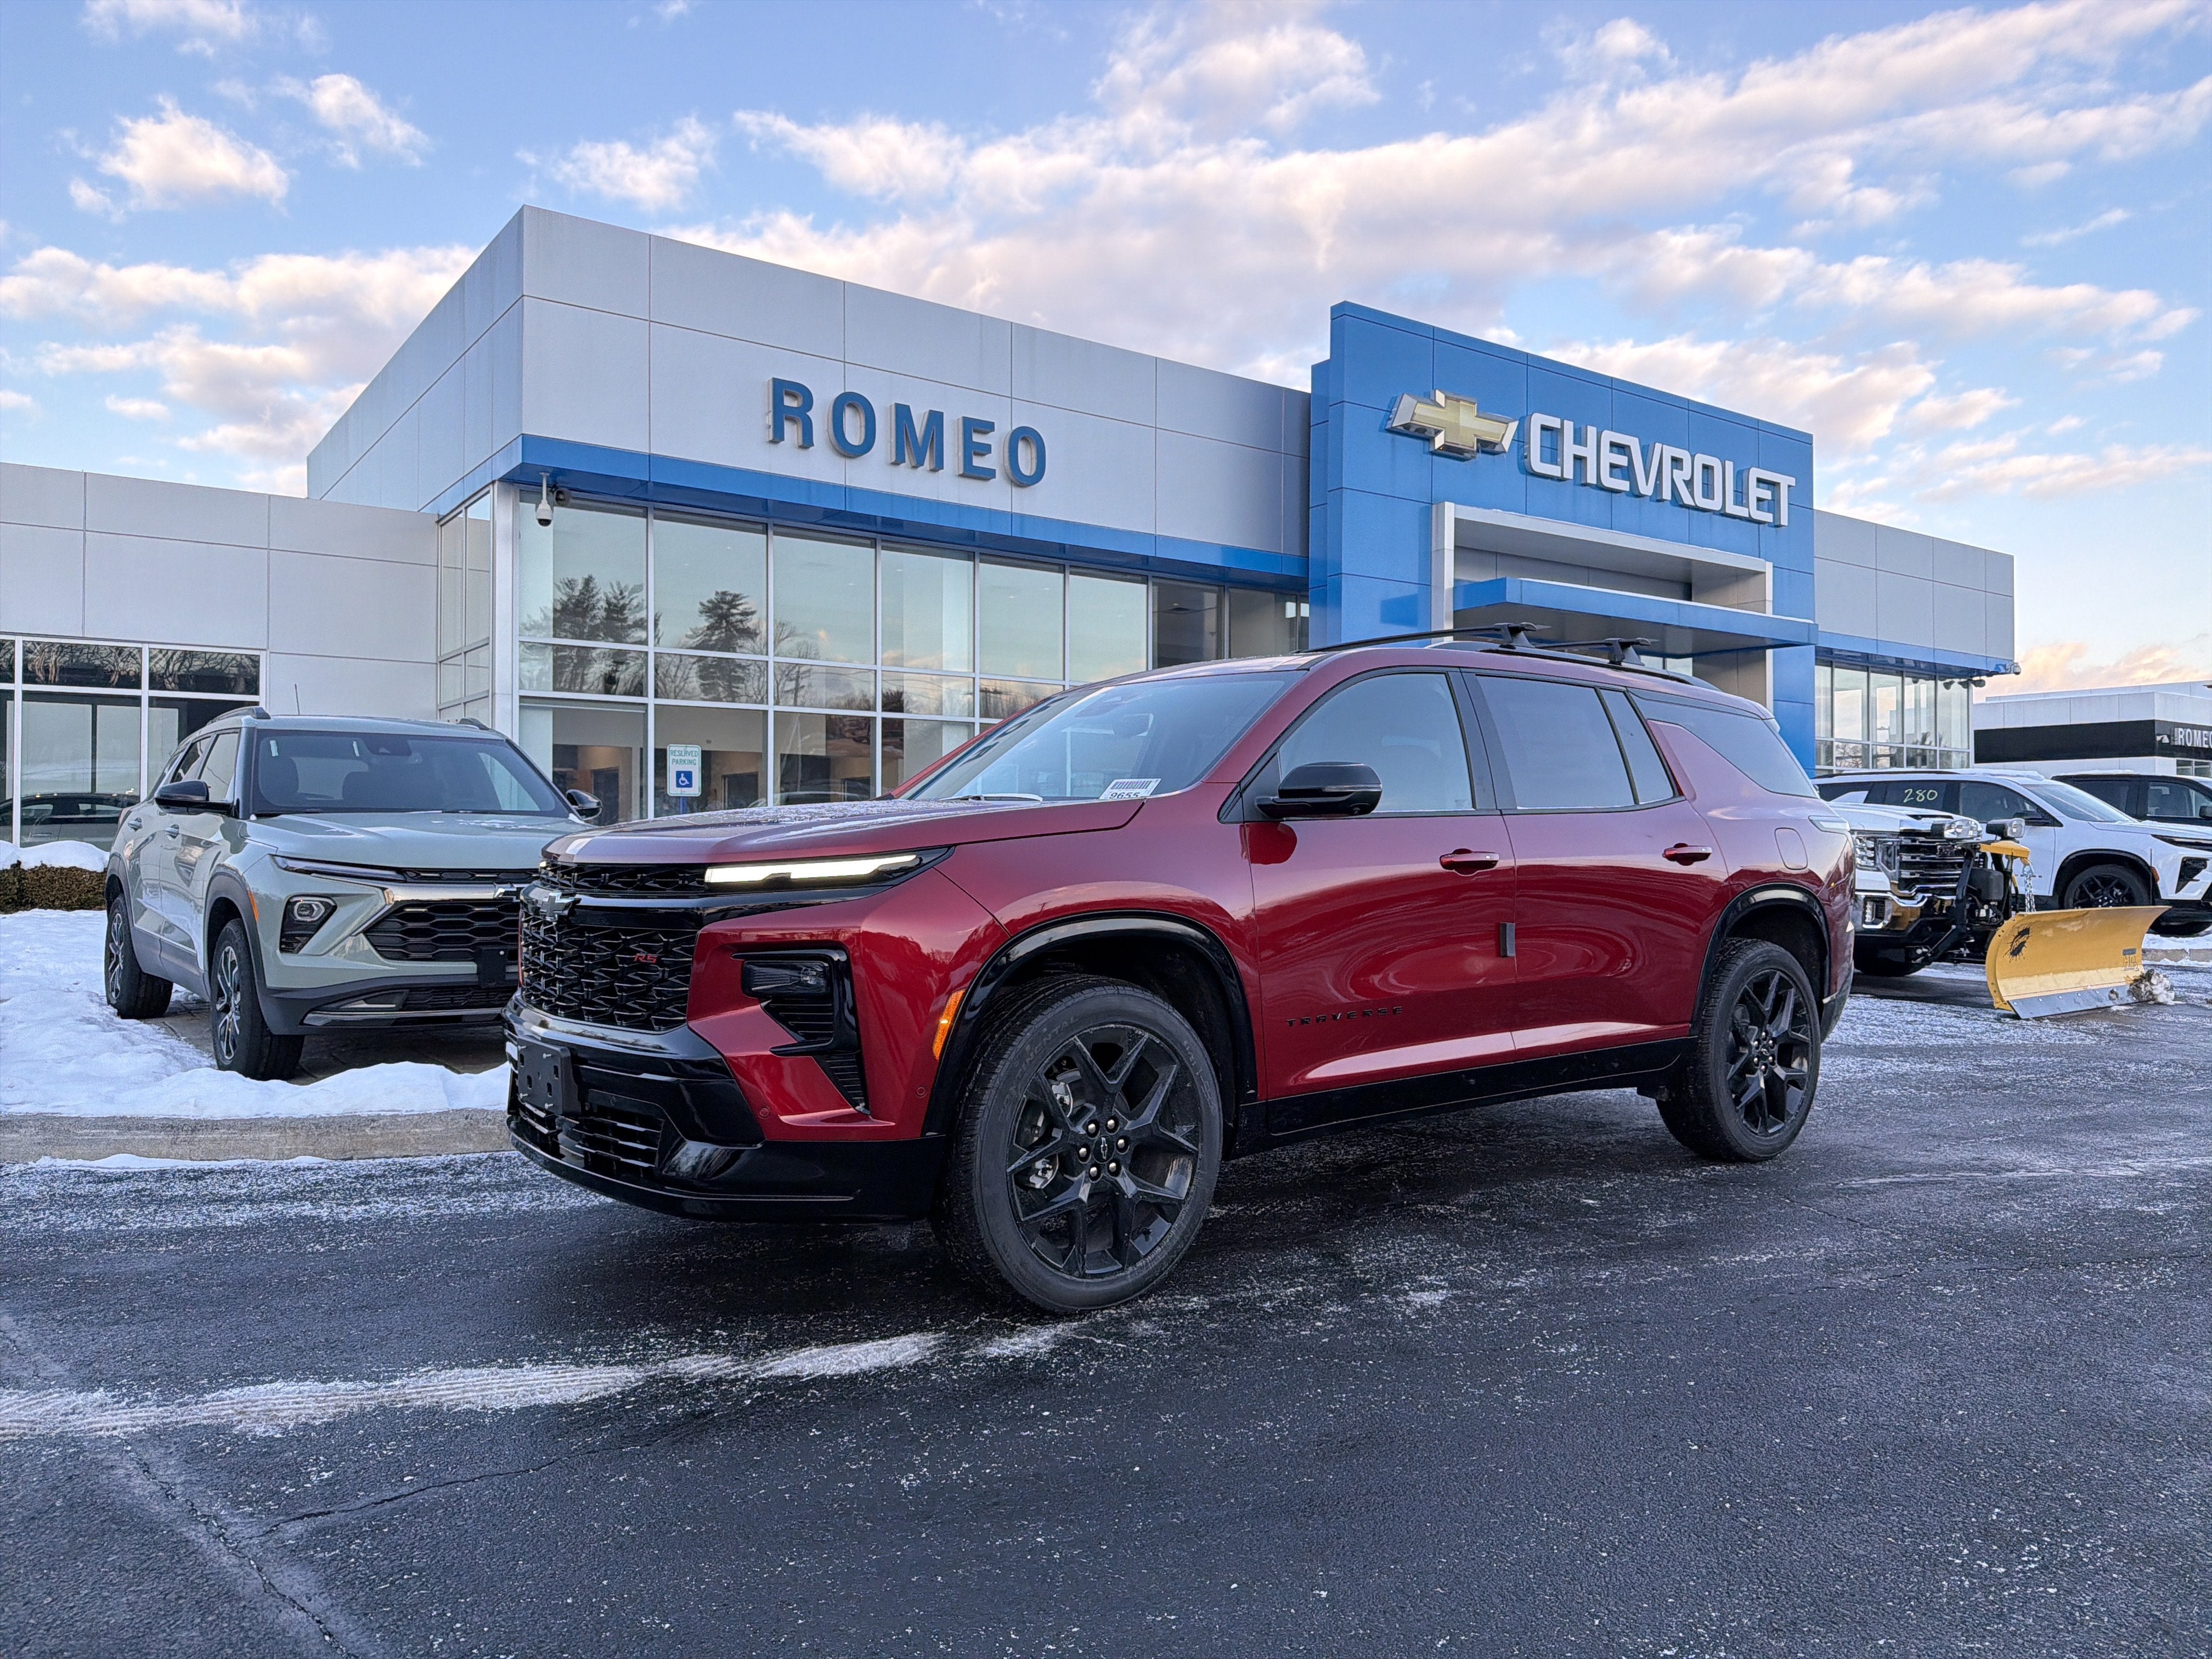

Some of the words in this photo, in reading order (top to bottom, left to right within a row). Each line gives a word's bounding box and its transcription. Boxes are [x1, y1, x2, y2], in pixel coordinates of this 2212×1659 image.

[767, 377, 1047, 487] ROMEO
[1523, 412, 1796, 527] CHEVROLET
[1903, 788, 1938, 803] 280
[634, 953, 658, 964] RS
[1286, 1006, 1403, 1027] TRAVERSE
